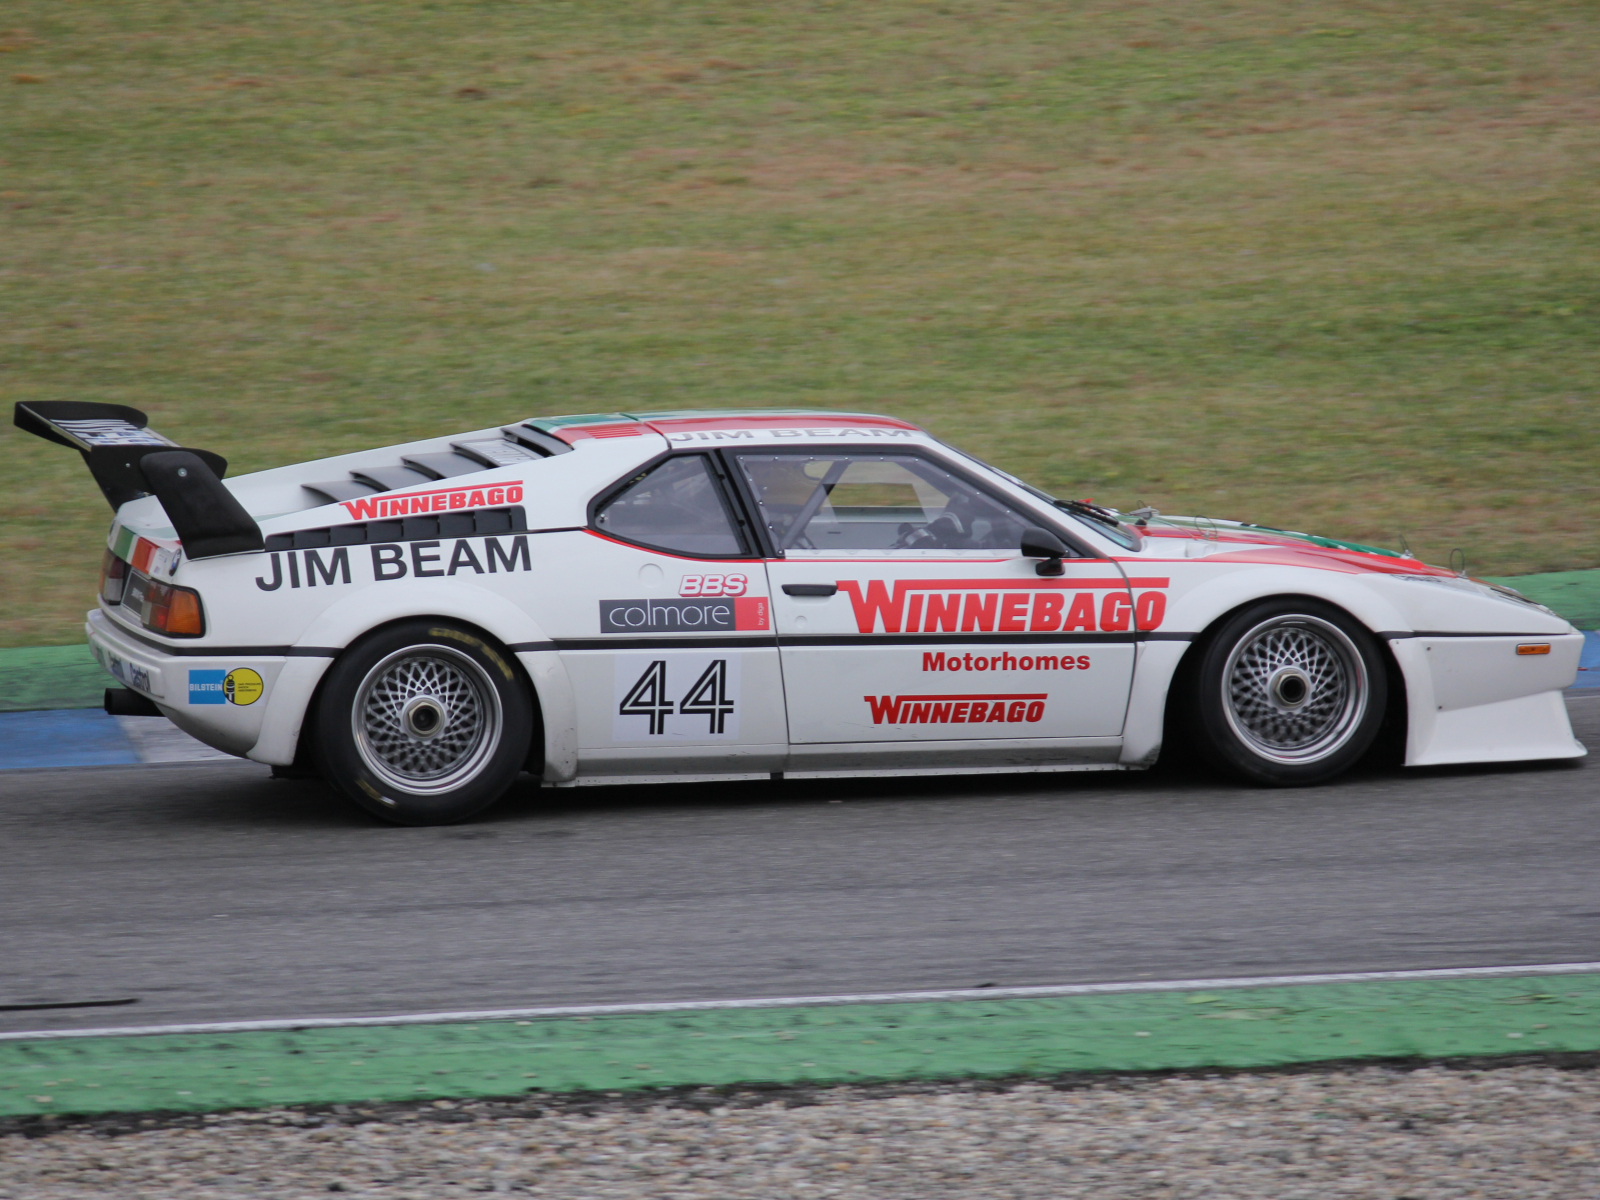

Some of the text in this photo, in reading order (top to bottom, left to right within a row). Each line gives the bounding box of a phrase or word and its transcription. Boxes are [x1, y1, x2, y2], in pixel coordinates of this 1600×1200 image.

[671, 428, 913, 442] JIM BEAM
[339, 480, 523, 520] WINNEBAGO
[255, 535, 532, 591] JIM BEAM
[678, 573, 748, 597] BBS
[609, 599, 731, 627] colmore
[835, 577, 1170, 633] WINNEBAGO
[922, 651, 1091, 672] Motorhomes
[189, 683, 223, 692] BILSTEIN
[619, 659, 735, 735] 44
[863, 693, 1048, 724] WINNEBAGO
